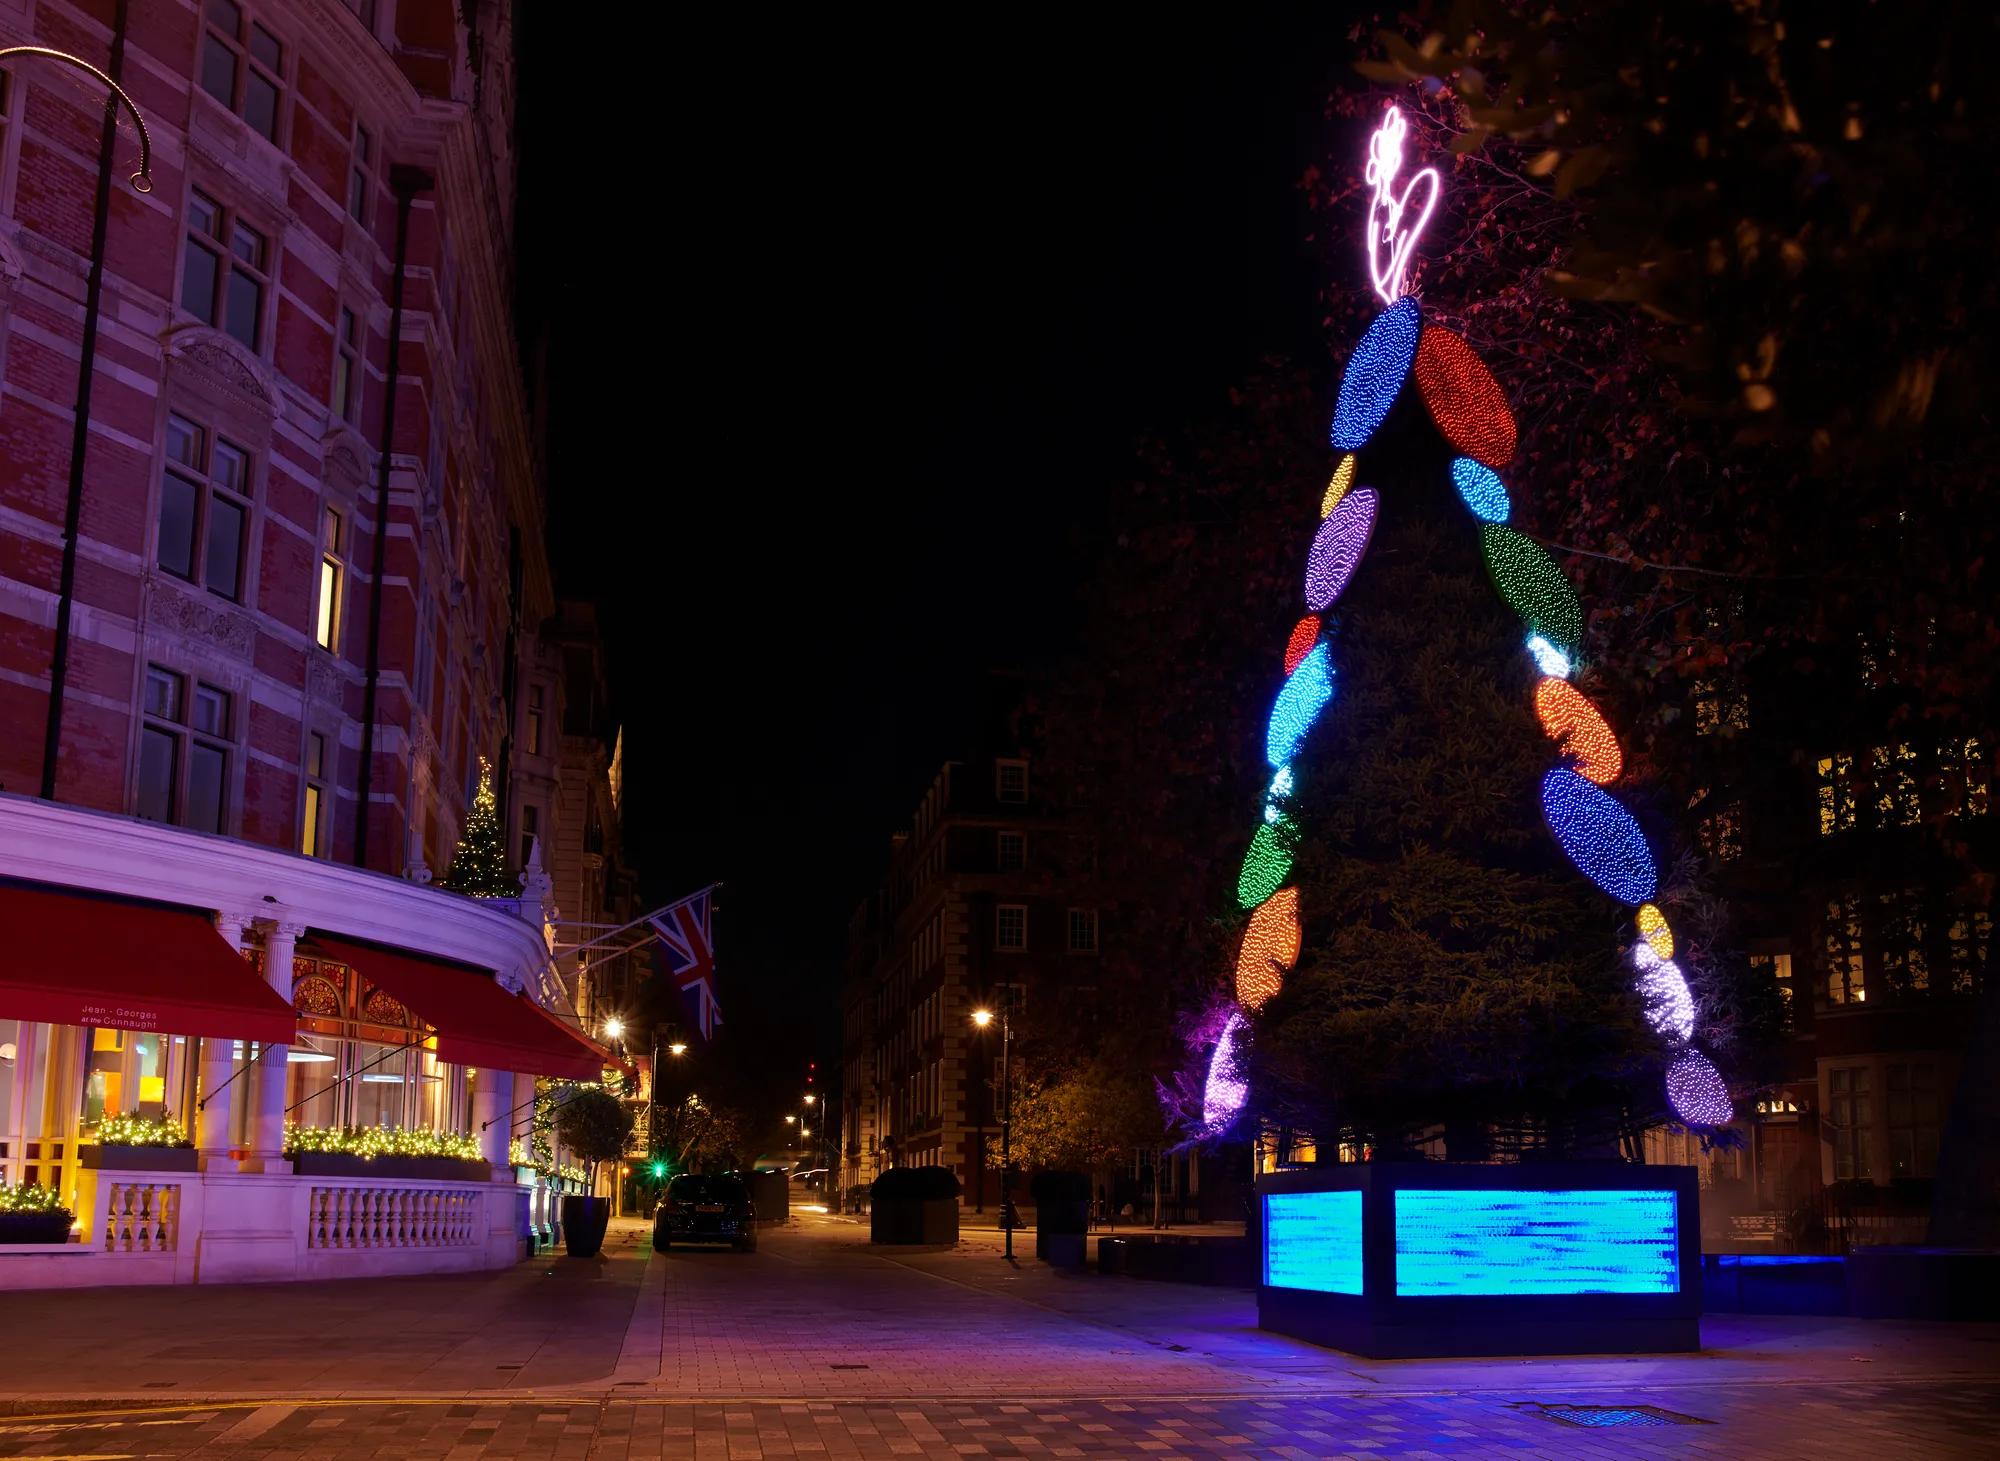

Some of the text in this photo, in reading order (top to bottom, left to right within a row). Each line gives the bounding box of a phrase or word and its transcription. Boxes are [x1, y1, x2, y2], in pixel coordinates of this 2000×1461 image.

[82, 1005, 106, 1014] Jean
[116, 1008, 157, 1019] Georges
[103, 1016, 157, 1029] Connaught
